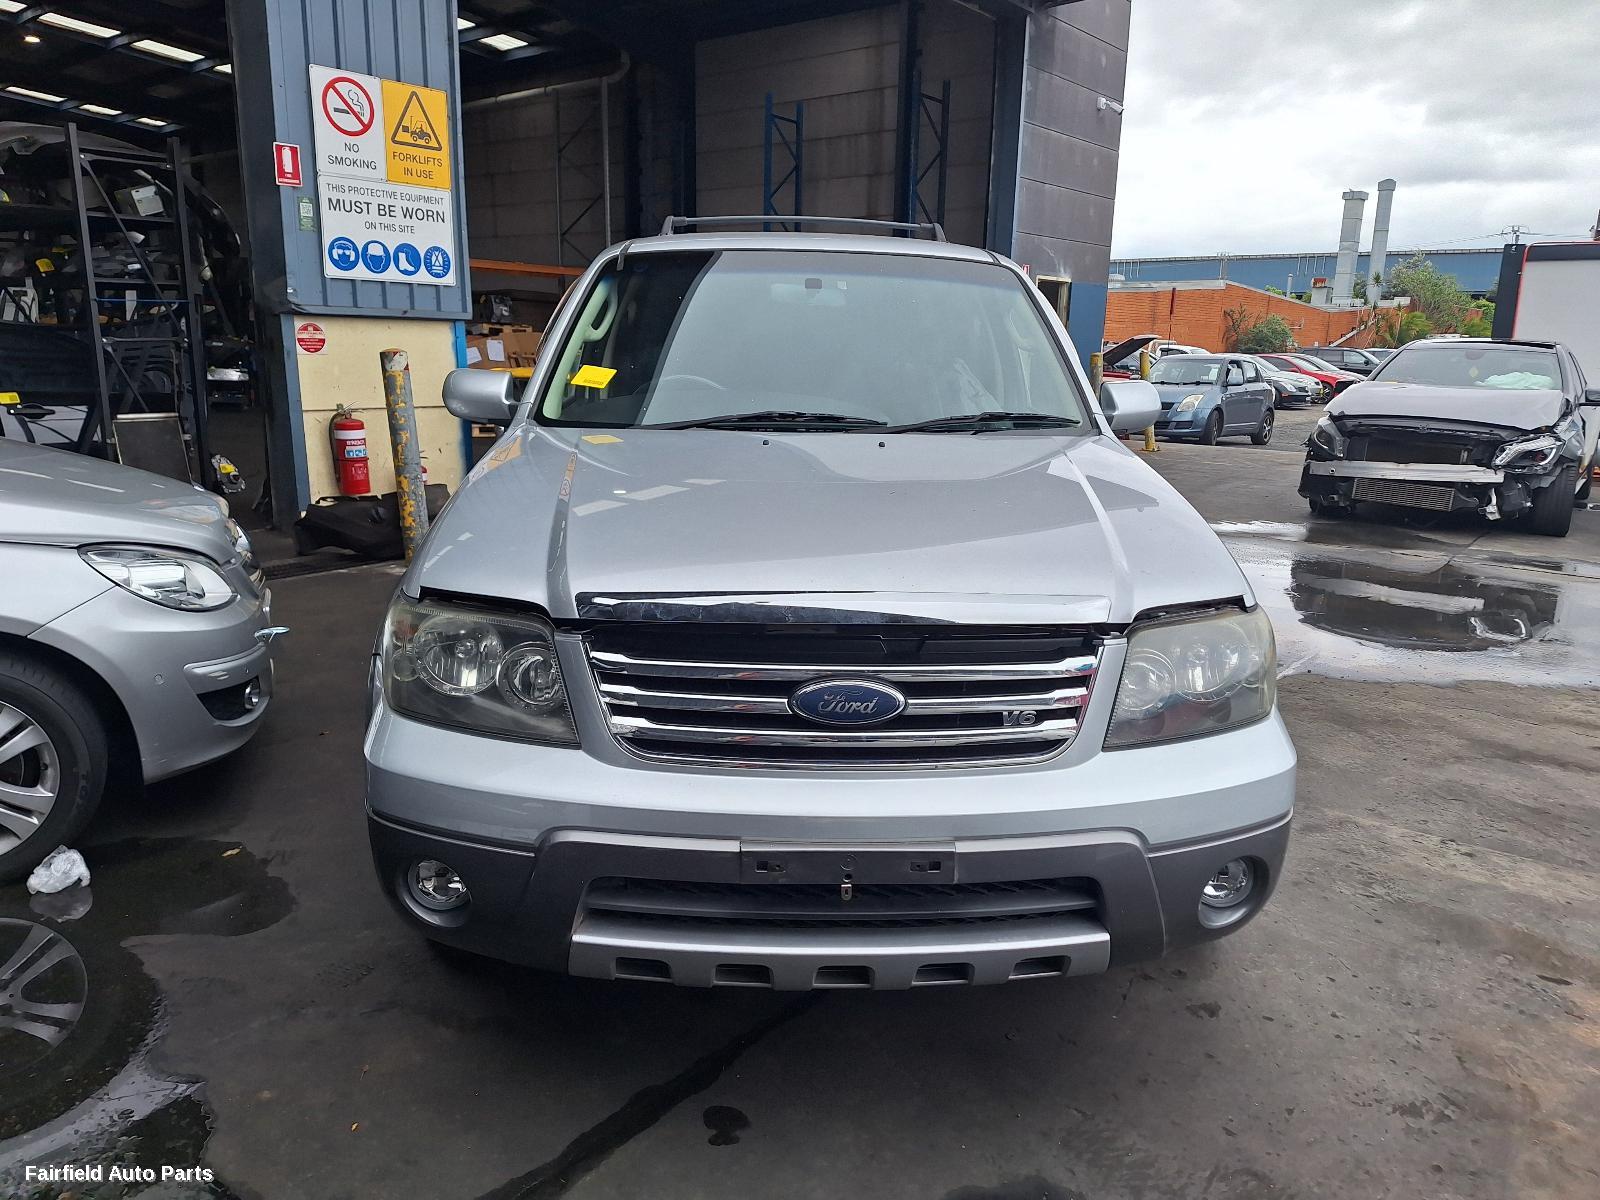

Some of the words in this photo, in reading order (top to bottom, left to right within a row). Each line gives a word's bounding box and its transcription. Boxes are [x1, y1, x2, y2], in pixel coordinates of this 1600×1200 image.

[344, 142, 359, 153] NO
[327, 154, 377, 170] SMOKING
[392, 151, 443, 167] FORKLIFTS
[403, 167, 413, 177] IN
[415, 168, 434, 180] USE
[326, 182, 346, 194] THIS
[348, 185, 398, 200] PROTECTIVE
[400, 192, 444, 206] EQUIPMENT
[327, 197, 372, 215] MUST
[377, 203, 397, 218] BE
[401, 206, 445, 223] WORN
[364, 221, 376, 231] ON
[379, 222, 397, 233] THIS
[398, 224, 415, 235] SITE
[817, 689, 878, 714] Ford
[1002, 710, 1037, 726] V6
